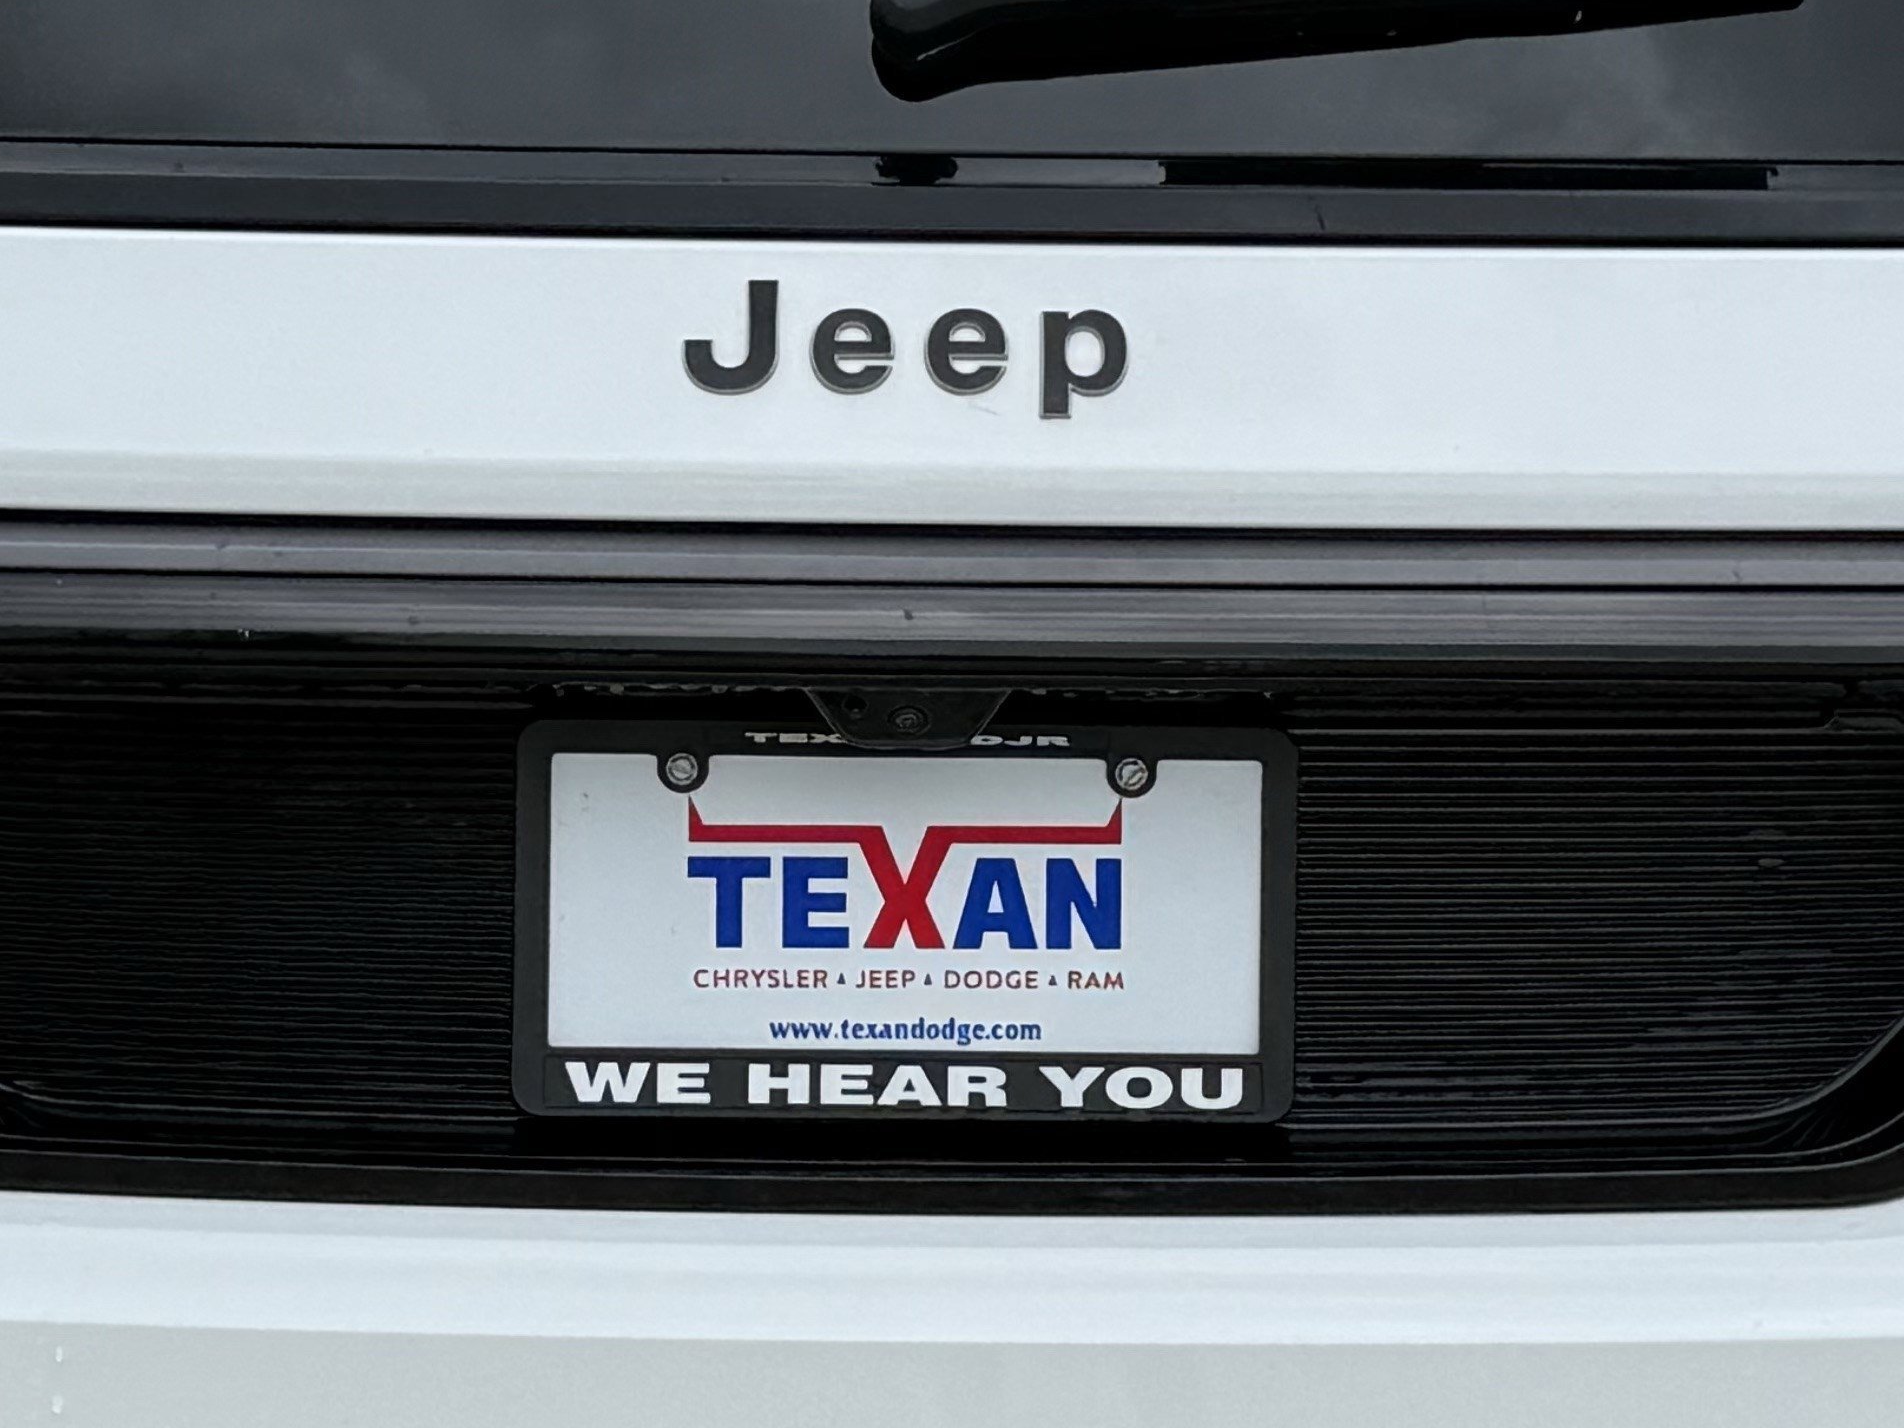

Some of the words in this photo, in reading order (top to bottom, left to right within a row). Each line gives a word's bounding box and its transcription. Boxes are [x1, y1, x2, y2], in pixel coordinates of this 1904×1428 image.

[683, 278, 1129, 419] Jeep
[687, 826, 1123, 950] TEXAN
[693, 969, 828, 989] CHRYSLER
[855, 970, 916, 989] JEEP
[944, 970, 1039, 990] DODGE
[1067, 971, 1125, 990] RAM
[769, 1017, 1042, 1044] www.texandodge.com
[565, 1061, 711, 1105] WE
[747, 1064, 1008, 1108] HEAR
[1039, 1066, 1244, 1110] YOU
